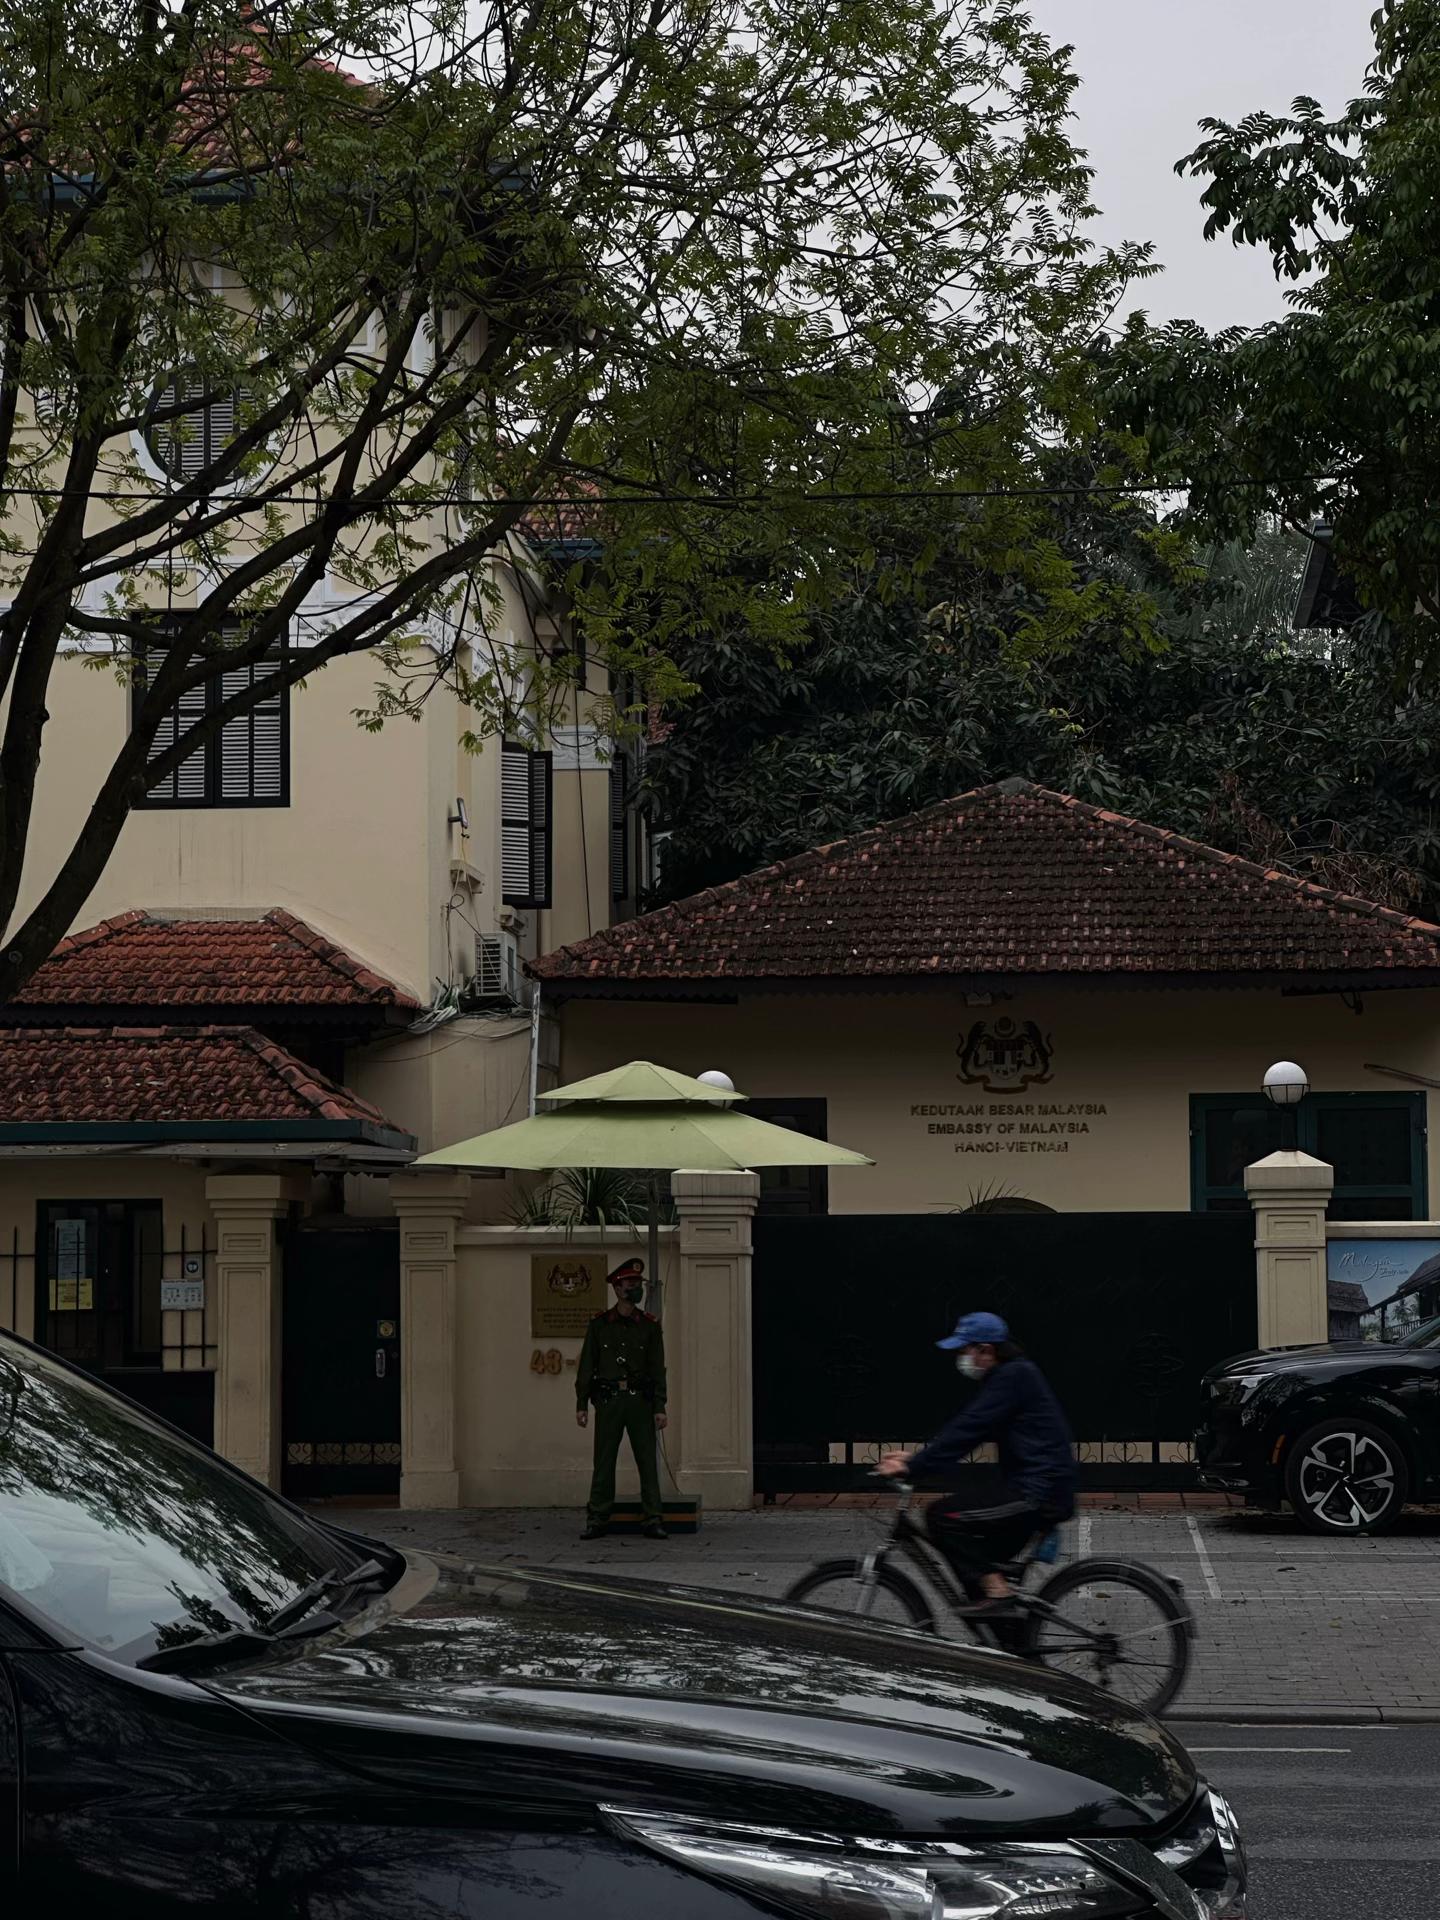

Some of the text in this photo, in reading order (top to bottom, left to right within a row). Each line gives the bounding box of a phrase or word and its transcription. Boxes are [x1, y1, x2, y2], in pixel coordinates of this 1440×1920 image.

[910, 1103, 1107, 1116] KEDUTAAN BESAR MALAYSIA
[927, 1122, 1090, 1134] EMBASSY OF MALAYSIA
